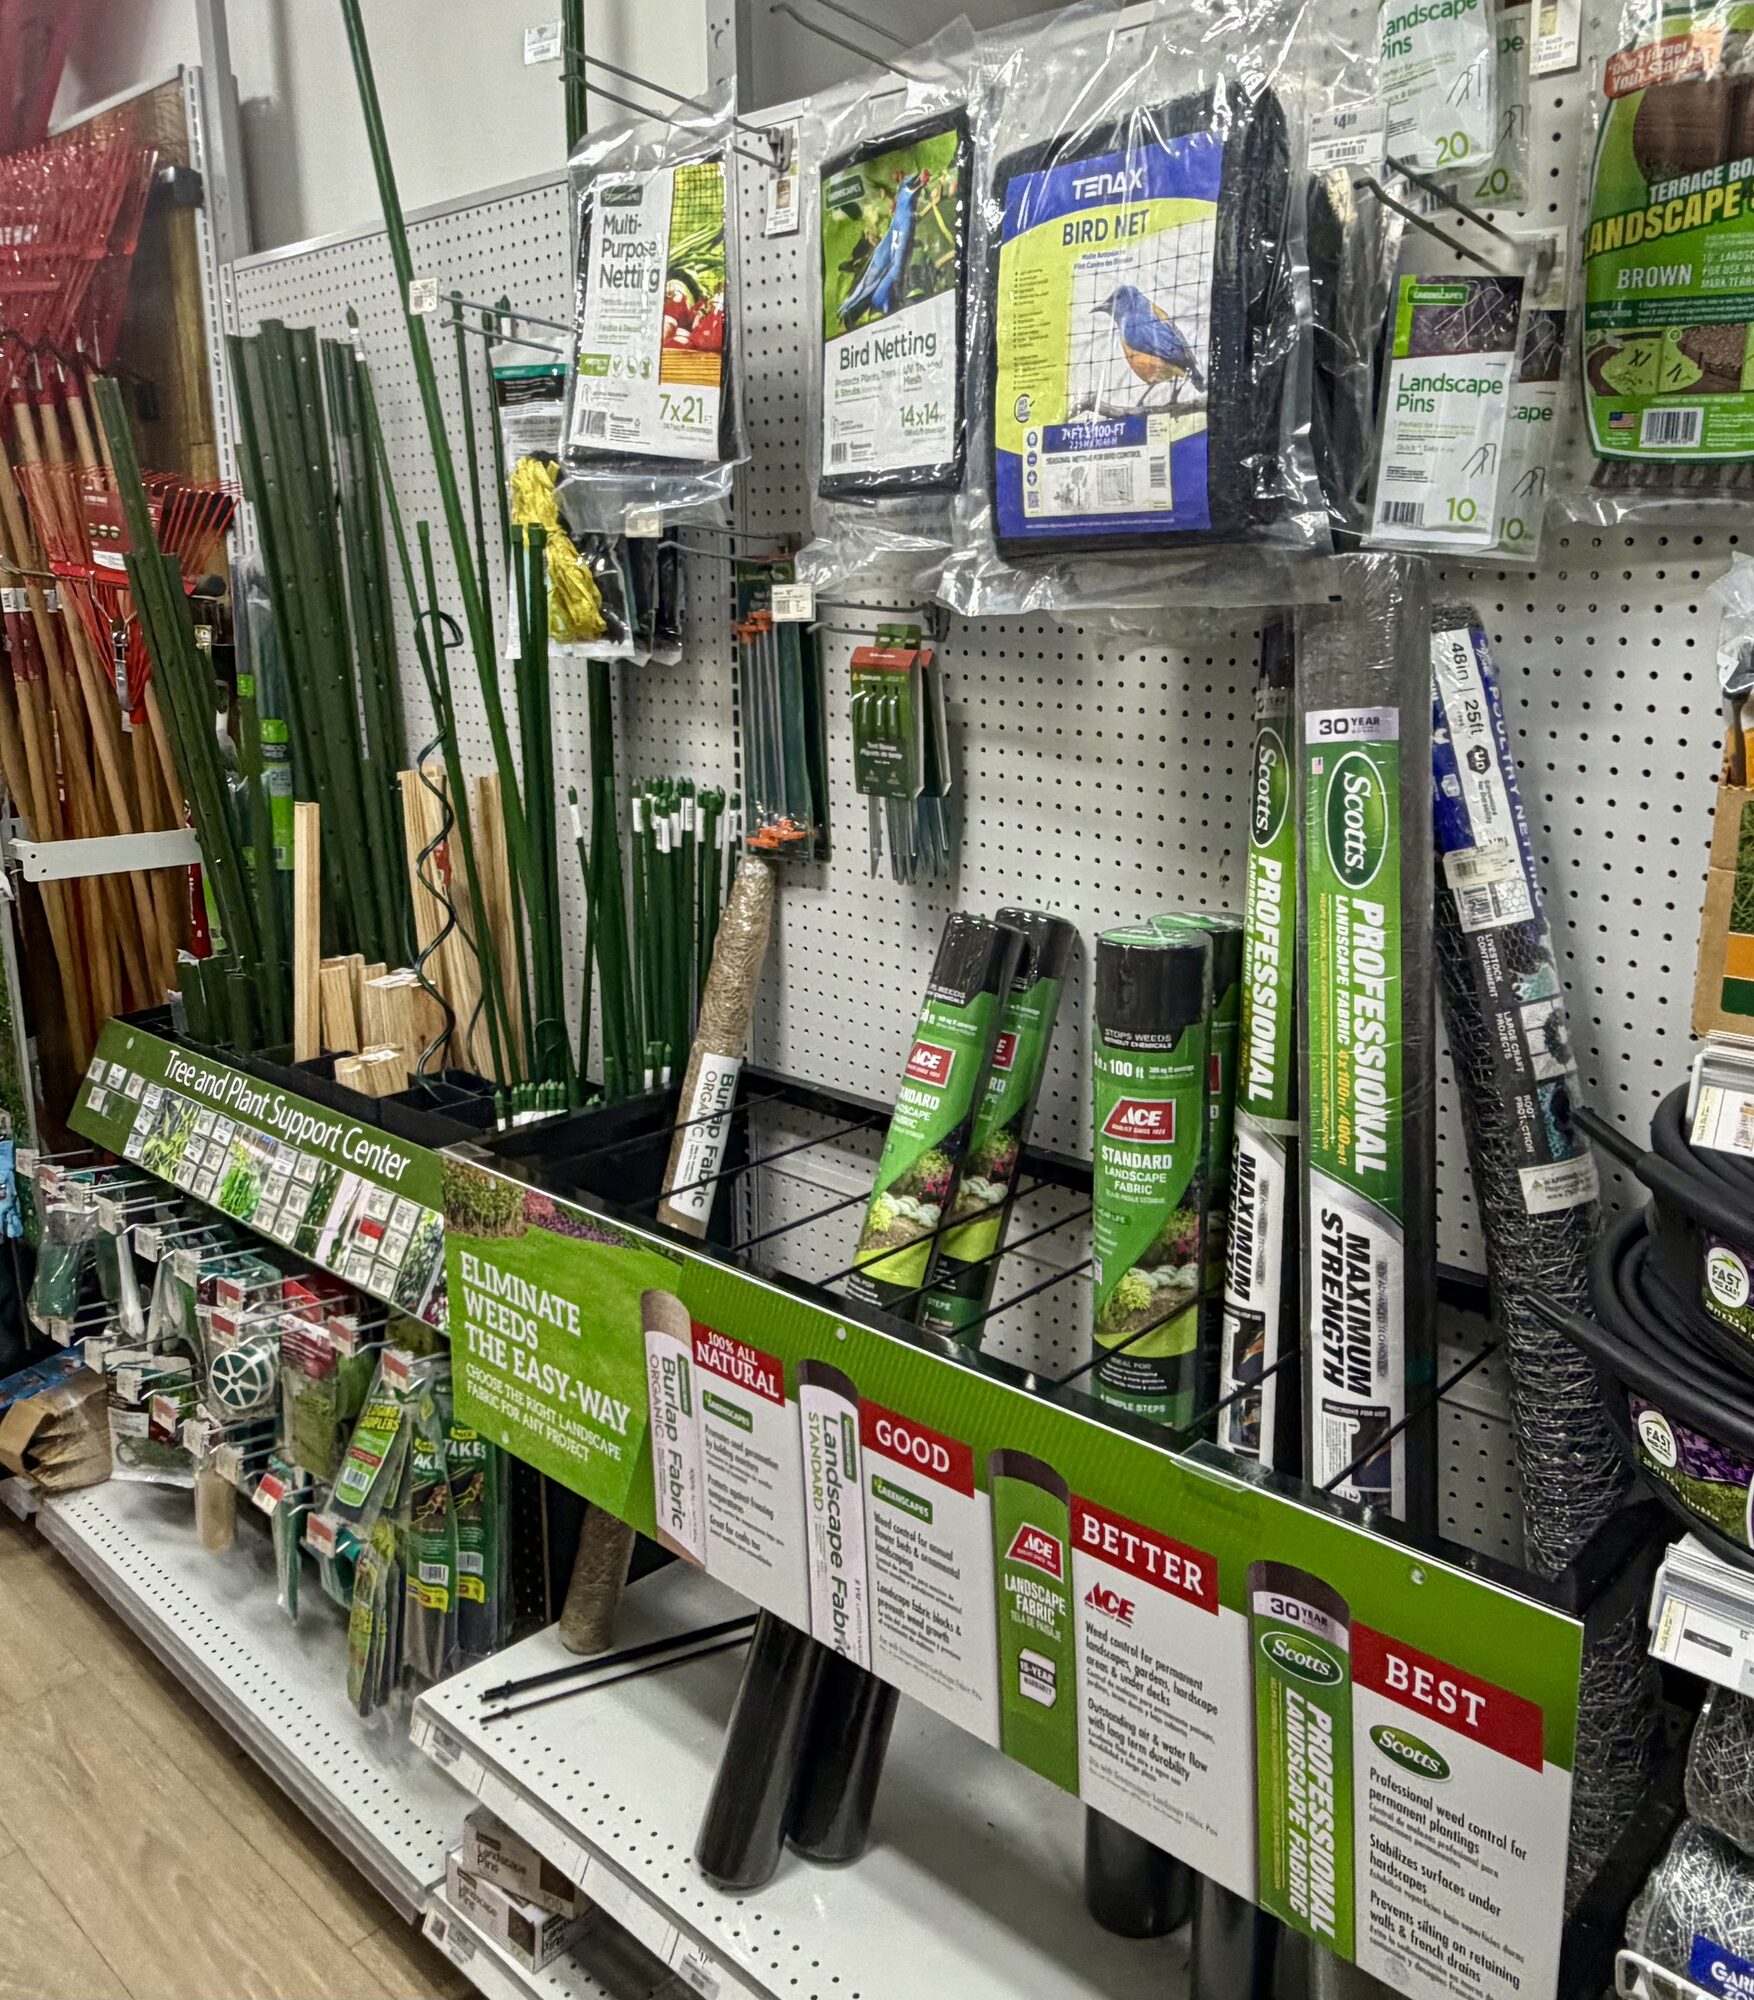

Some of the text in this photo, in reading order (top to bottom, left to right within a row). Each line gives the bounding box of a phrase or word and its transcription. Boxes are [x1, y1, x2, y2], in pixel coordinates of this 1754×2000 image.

[1383, 0, 1477, 37] andscape
[1435, 131, 1470, 166] 20
[1072, 167, 1143, 200] TENAX
[1650, 165, 1725, 204] TERRACE
[602, 214, 641, 235] Multi-
[1062, 209, 1149, 246] BIRD NET
[1589, 182, 1742, 254] ANDSCAPE
[599, 265, 660, 292] Nettig
[1616, 264, 1692, 289] BROWN
[840, 331, 936, 370] Bird Netting
[1396, 394, 1435, 413] Pins
[1399, 372, 1503, 397] Landscape
[1447, 497, 1476, 522] 10
[1451, 642, 1485, 736] 48in 25ft
[1319, 716, 1380, 735] 30 YEAR
[1489, 685, 1521, 797] POULTRY
[1255, 745, 1277, 834] Scotts
[1343, 771, 1371, 871] Scotts
[1335, 894, 1350, 988] LANDSCAPE
[1476, 935, 1499, 998] CONTAINMENT
[1484, 933, 1502, 982] LIVESTOCK
[1249, 856, 1283, 1102] PROFESSIONAL
[1105, 1029, 1172, 1043] STOPS WEEDS
[1336, 989, 1349, 1046] FABRIC
[1352, 899, 1388, 1175] PROFESSIONAL
[1495, 1012, 1512, 1060] PROJECTS
[1503, 1011, 1525, 1073] LARGE CRAFT
[911, 1047, 941, 1070] ACE
[1109, 1060, 1133, 1078] 100
[1136, 1068, 1144, 1079] ft
[1131, 1041, 1172, 1049] CHEMICALS
[164, 1049, 412, 1181] Tree and Plant Support Center
[1120, 1106, 1163, 1127] ACE
[1524, 1093, 1535, 1121] ROOT
[1102, 1145, 1172, 1170] STANDARD
[1105, 1166, 1167, 1183] LANDSCAPE
[1114, 1180, 1153, 1196] FABRIC
[1234, 1151, 1256, 1302] MAXIMUM
[460, 1251, 581, 1337] ELIMINATE
[1321, 1208, 1345, 1389] STRENGTH
[1711, 1264, 1742, 1290] FAST
[463, 1285, 538, 1350] WEEDS
[1346, 1232, 1372, 1398] MAXIMUM
[464, 1321, 508, 1370] THE
[696, 1340, 780, 1399] NATURAL
[708, 1330, 758, 1367] 100% ALL
[466, 1362, 622, 1462] CHOOSE THE RIGHT LANDSCAPE
[467, 1380, 590, 1463] FABRIC FOR ANY PROJECT
[649, 1354, 664, 1439] ORGANIC
[1135, 1403, 1166, 1413] STEPS
[662, 1356, 686, 1531] Burlap Fabric
[808, 1411, 824, 1512] STANDARD
[875, 1419, 950, 1473] GOOD
[1646, 1425, 1672, 1453] FAST
[822, 1415, 844, 1570] Landscape
[877, 1484, 930, 1518] GREENSCAPES
[1024, 1533, 1054, 1560] ACE
[1082, 1513, 1204, 1596] BETTER
[1004, 1573, 1067, 1617] LANDSCAPE
[1015, 1594, 1055, 1626] FABRIC
[1083, 1581, 1136, 1624] ACE
[1270, 1596, 1329, 1626] 30 YEAR
[1085, 1620, 1203, 1691] Weed control for permanent
[1086, 1655, 1170, 1708] areas under decks
[1271, 1638, 1332, 1676] Scotts
[1134, 1661, 1171, 1692] gardens,
[1173, 1682, 1218, 1716] hardscape
[1385, 1653, 1486, 1727] BEST
[1088, 1698, 1208, 1773] Outstanding air & water flow
[1088, 1715, 1190, 1782] with long term durability
[1379, 1730, 1441, 1773] Scotts
[1286, 1686, 1309, 1919] LANDSCAPE FABRIC
[1305, 1700, 1336, 1940] PROFESSIONAL
[1370, 1767, 1527, 1861] Professional weed control for
[1370, 1788, 1480, 1855] permanent plantings
[1370, 1851, 1427, 1895] hardscapes
[1370, 1834, 1502, 1916] Stabilizes surfaces under
[1370, 1890, 1521, 1991] Prevents silting on retaining
[1370, 1910, 1481, 1983] walls & french drains
